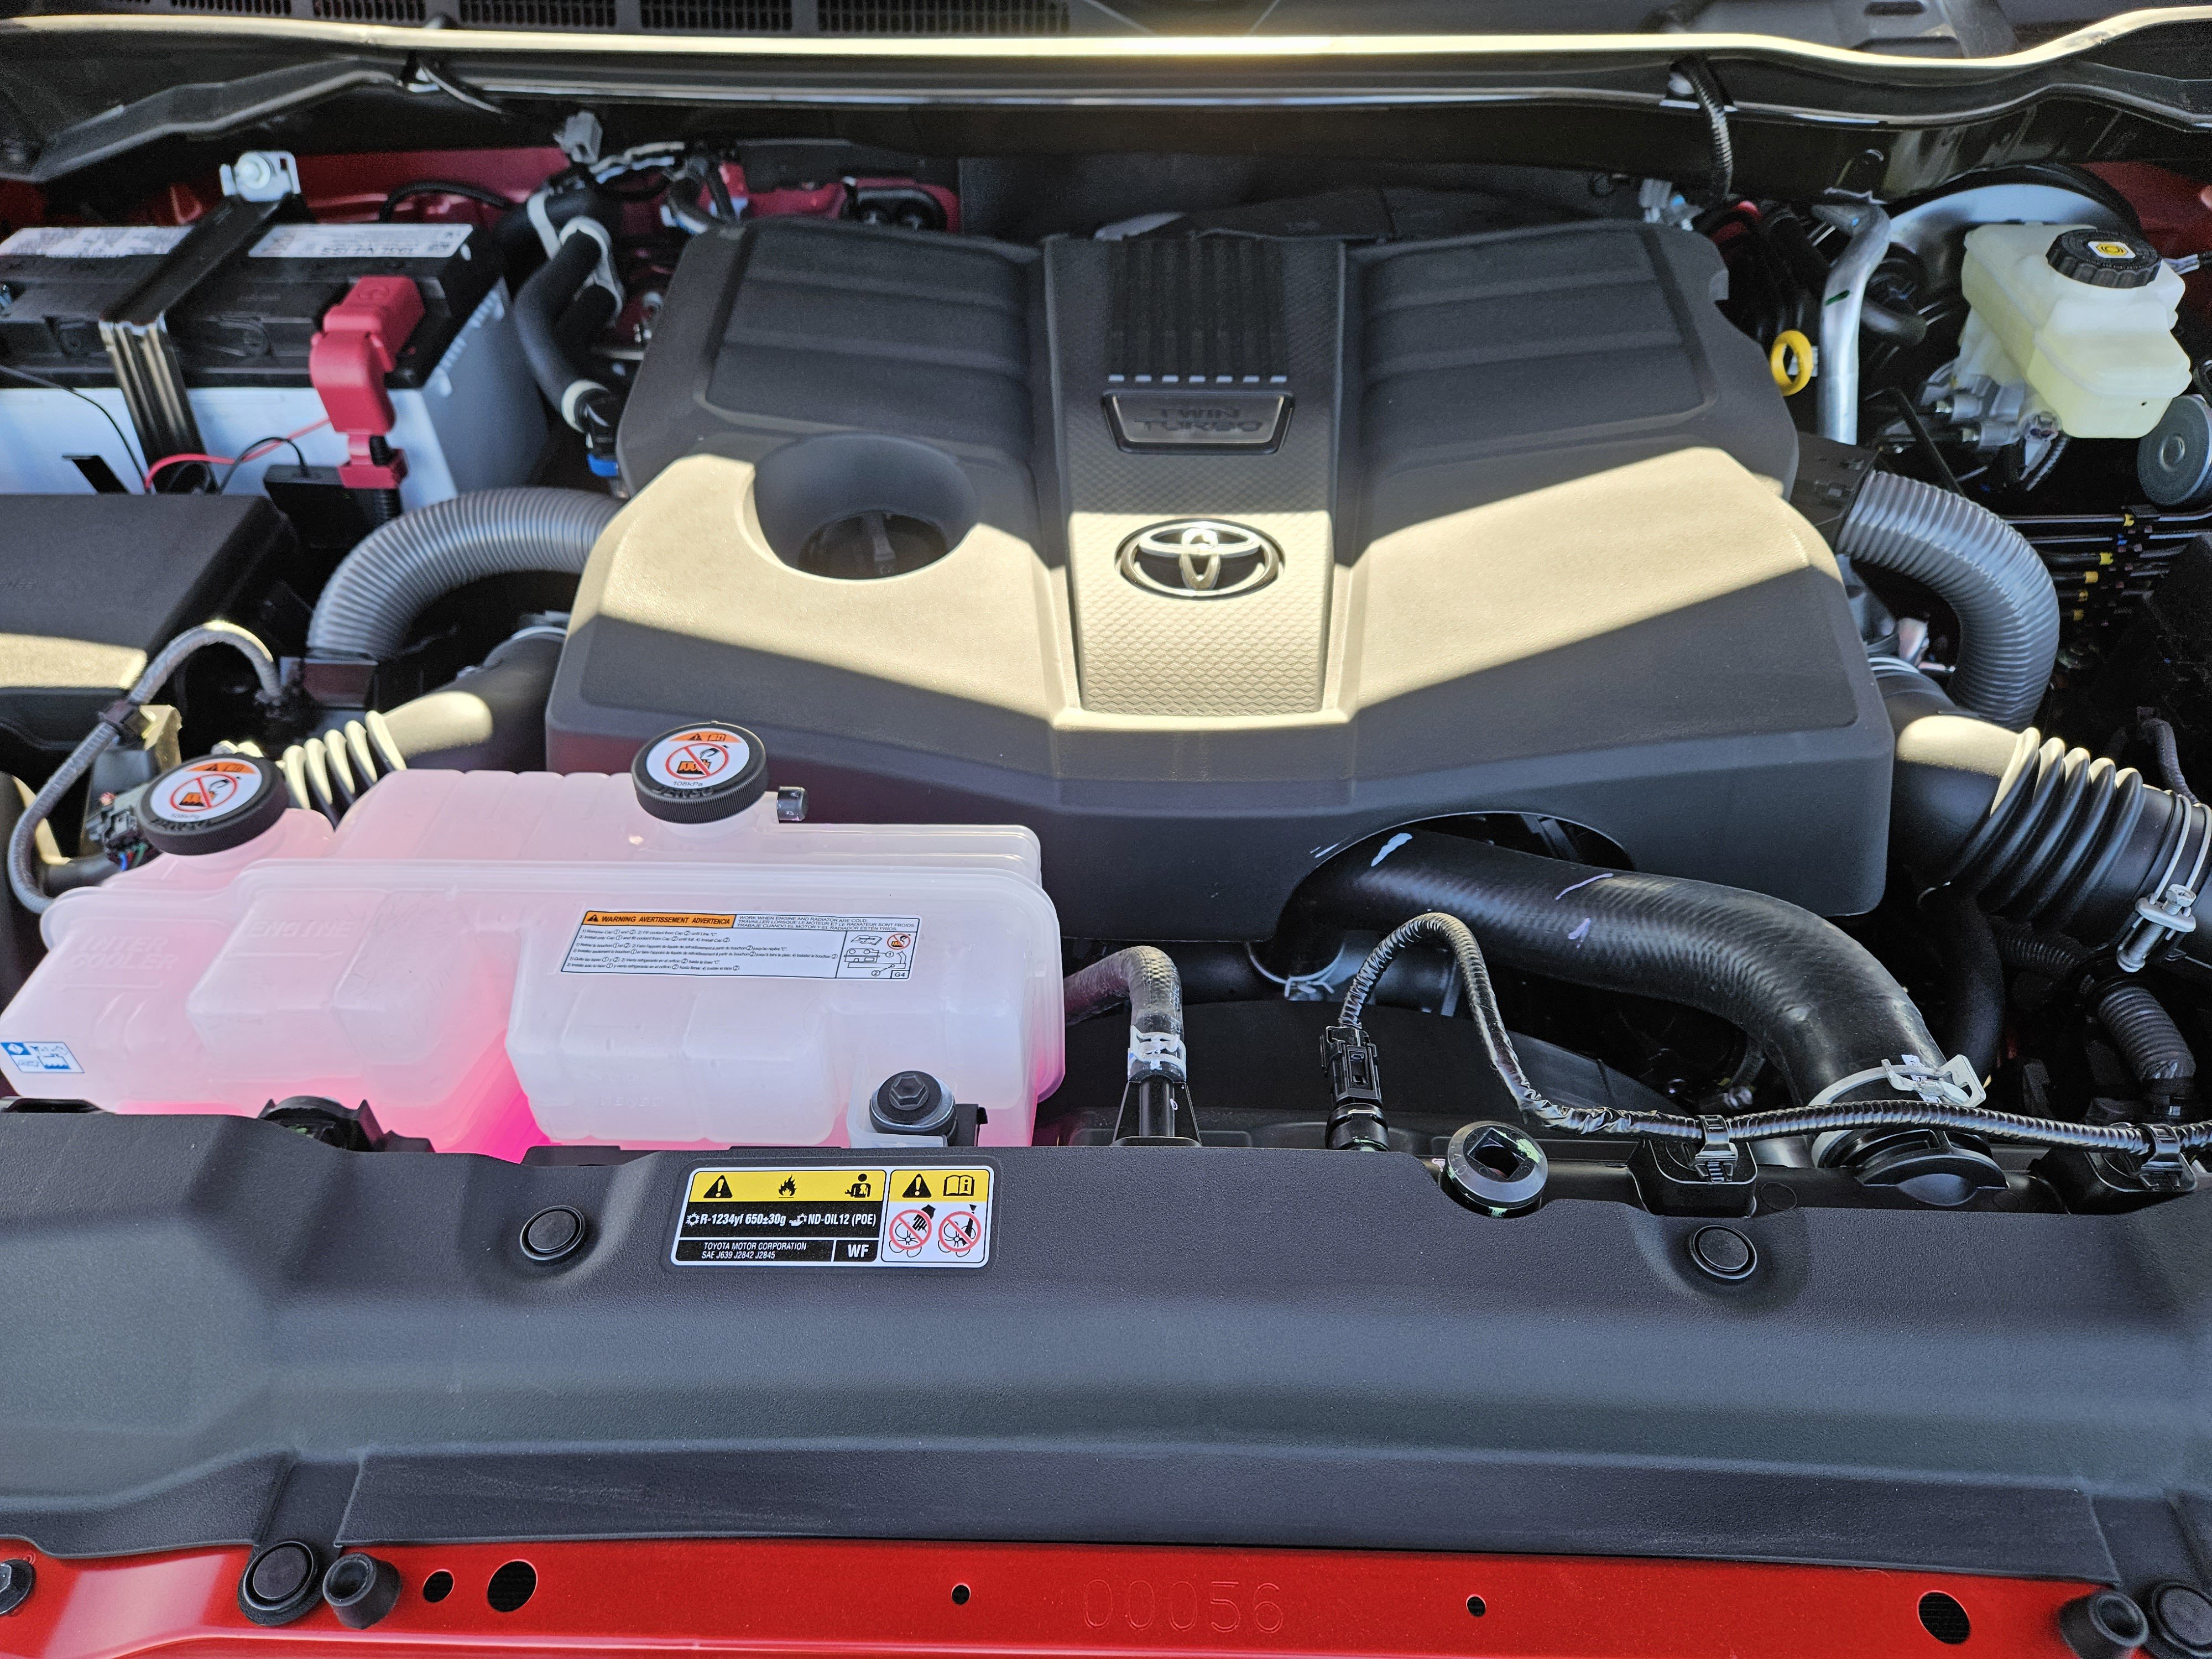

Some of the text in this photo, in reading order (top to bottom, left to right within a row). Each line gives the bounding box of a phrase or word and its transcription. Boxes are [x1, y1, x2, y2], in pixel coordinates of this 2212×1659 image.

[1151, 408, 1240, 419] TWIN
[1134, 420, 1264, 432] TURBO
[247, 920, 355, 939] ENGINE
[77, 935, 169, 952] INTER
[68, 952, 180, 971] COOLER
[600, 1097, 665, 1108] DENSO
[700, 1213, 744, 1227] R-1234yf
[745, 1213, 787, 1227] 650±30g
[851, 1213, 877, 1227] (POE)
[703, 1241, 807, 1251] TOYOTA MOTOR CORPORATION
[847, 1244, 870, 1258] WF
[701, 1251, 776, 1259] SAE J639 J2842 J2845
[1084, 1579, 1284, 1633] 00056
